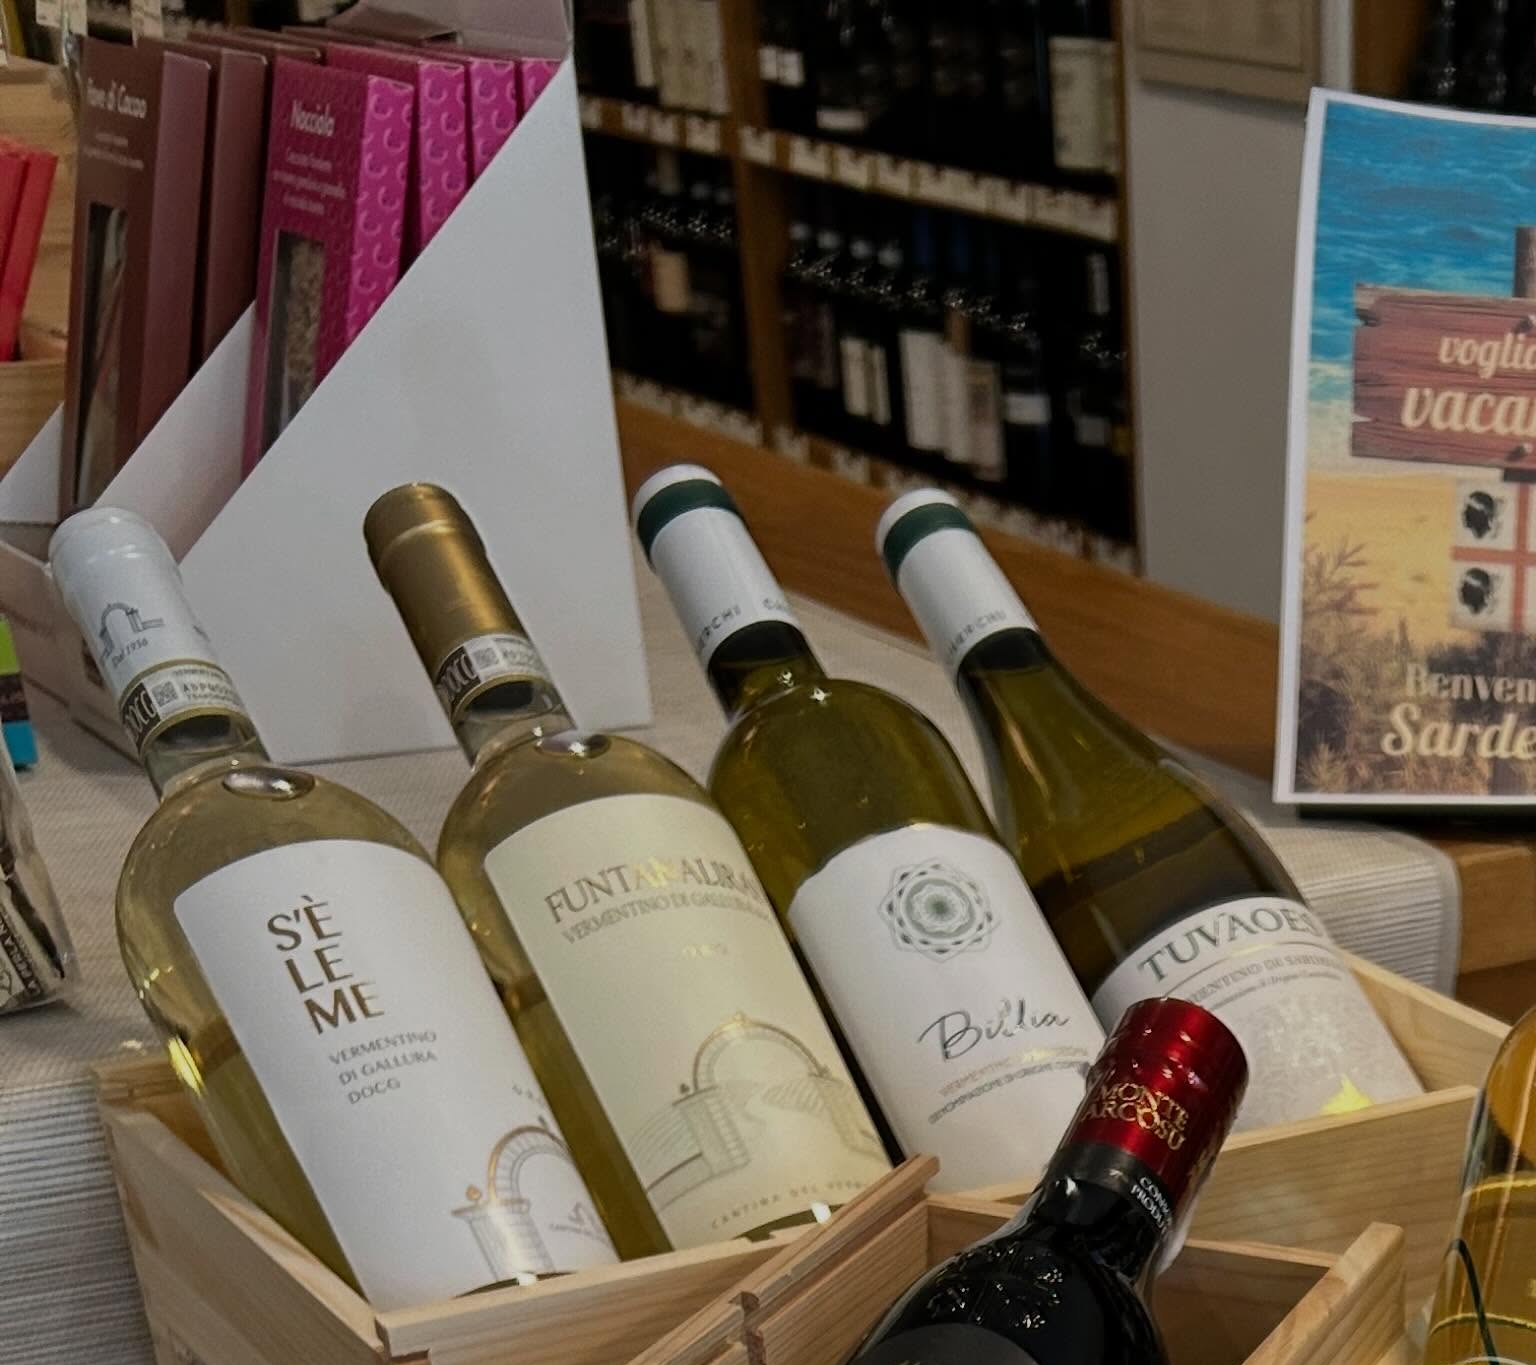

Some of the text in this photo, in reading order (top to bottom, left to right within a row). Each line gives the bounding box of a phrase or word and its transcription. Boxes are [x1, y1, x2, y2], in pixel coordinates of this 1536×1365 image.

[290, 100, 336, 137] Nocciola
[284, 944, 354, 994] LE
[304, 981, 386, 1035] ME
[329, 1030, 437, 1065] VERMENTINO
[339, 1050, 438, 1086] DI GALLURA
